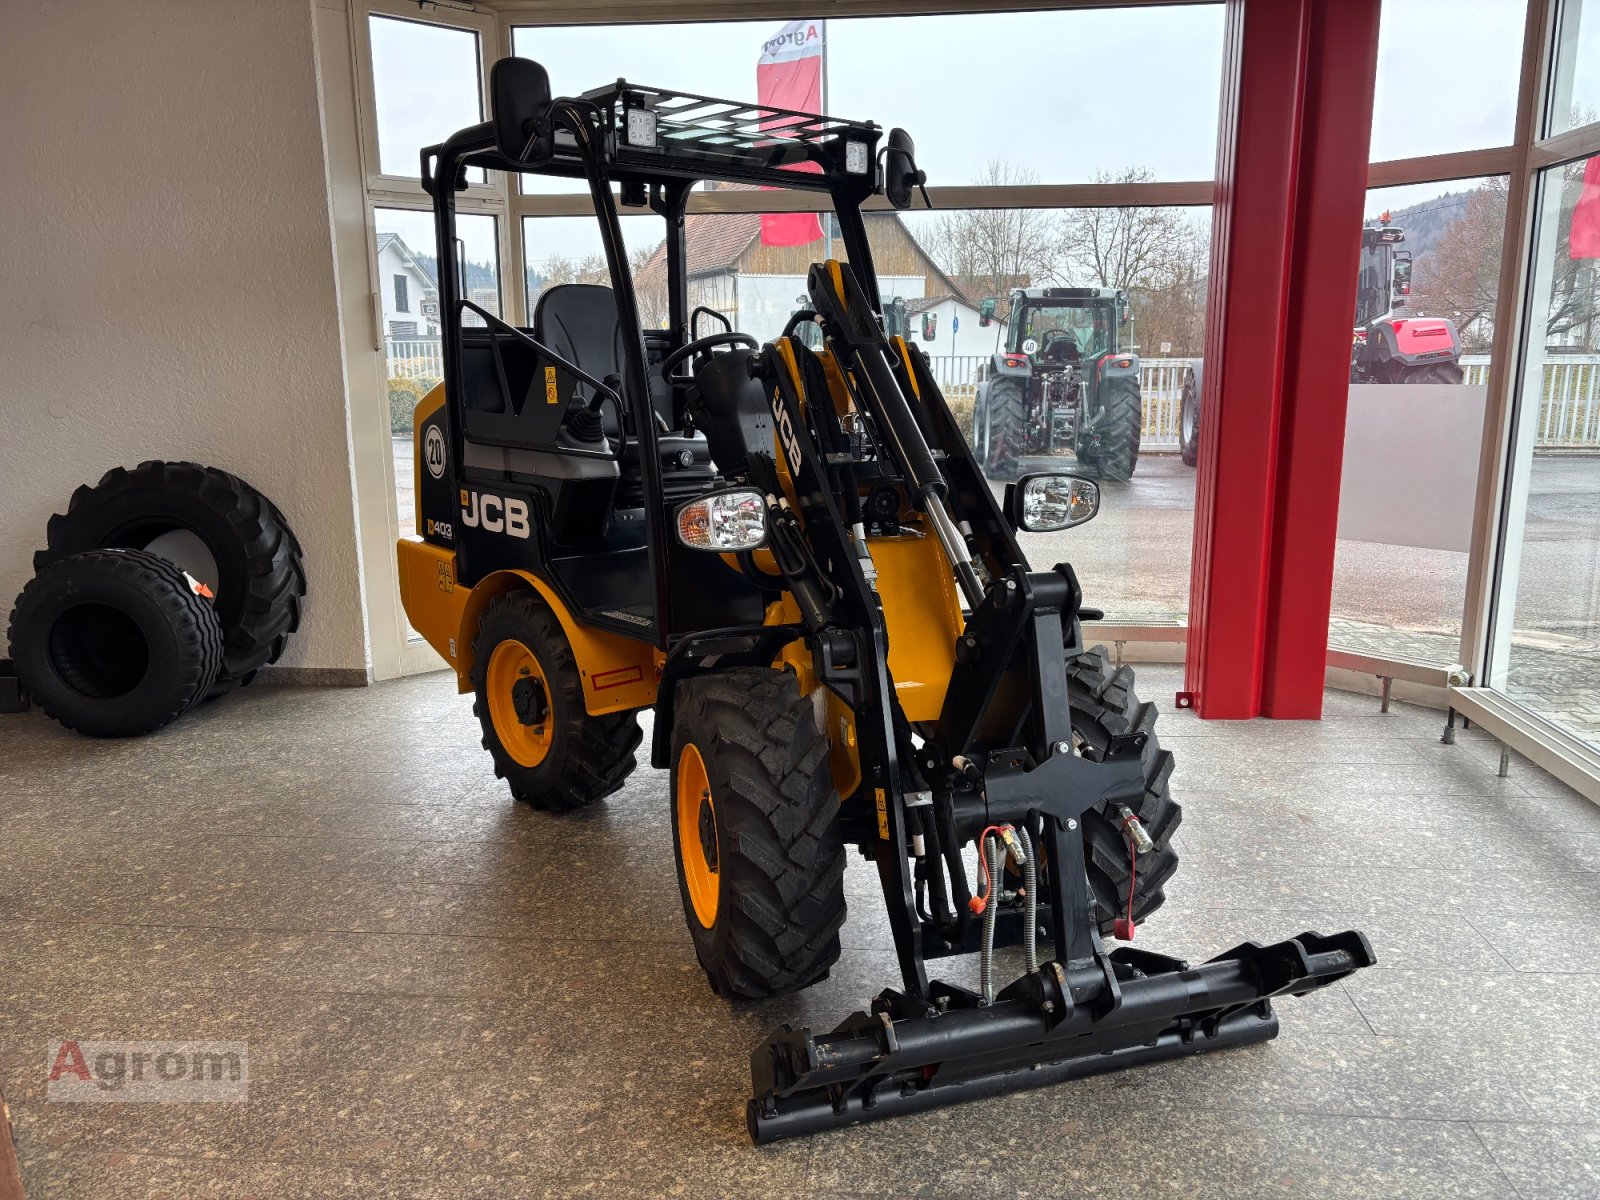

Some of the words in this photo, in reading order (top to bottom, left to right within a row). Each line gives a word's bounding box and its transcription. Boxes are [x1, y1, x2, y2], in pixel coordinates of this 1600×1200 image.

[1025, 342, 1035, 352] 40
[772, 398, 802, 477] JCB
[429, 438, 442, 466] 20
[434, 521, 453, 537] 403
[461, 491, 530, 539] JCB
